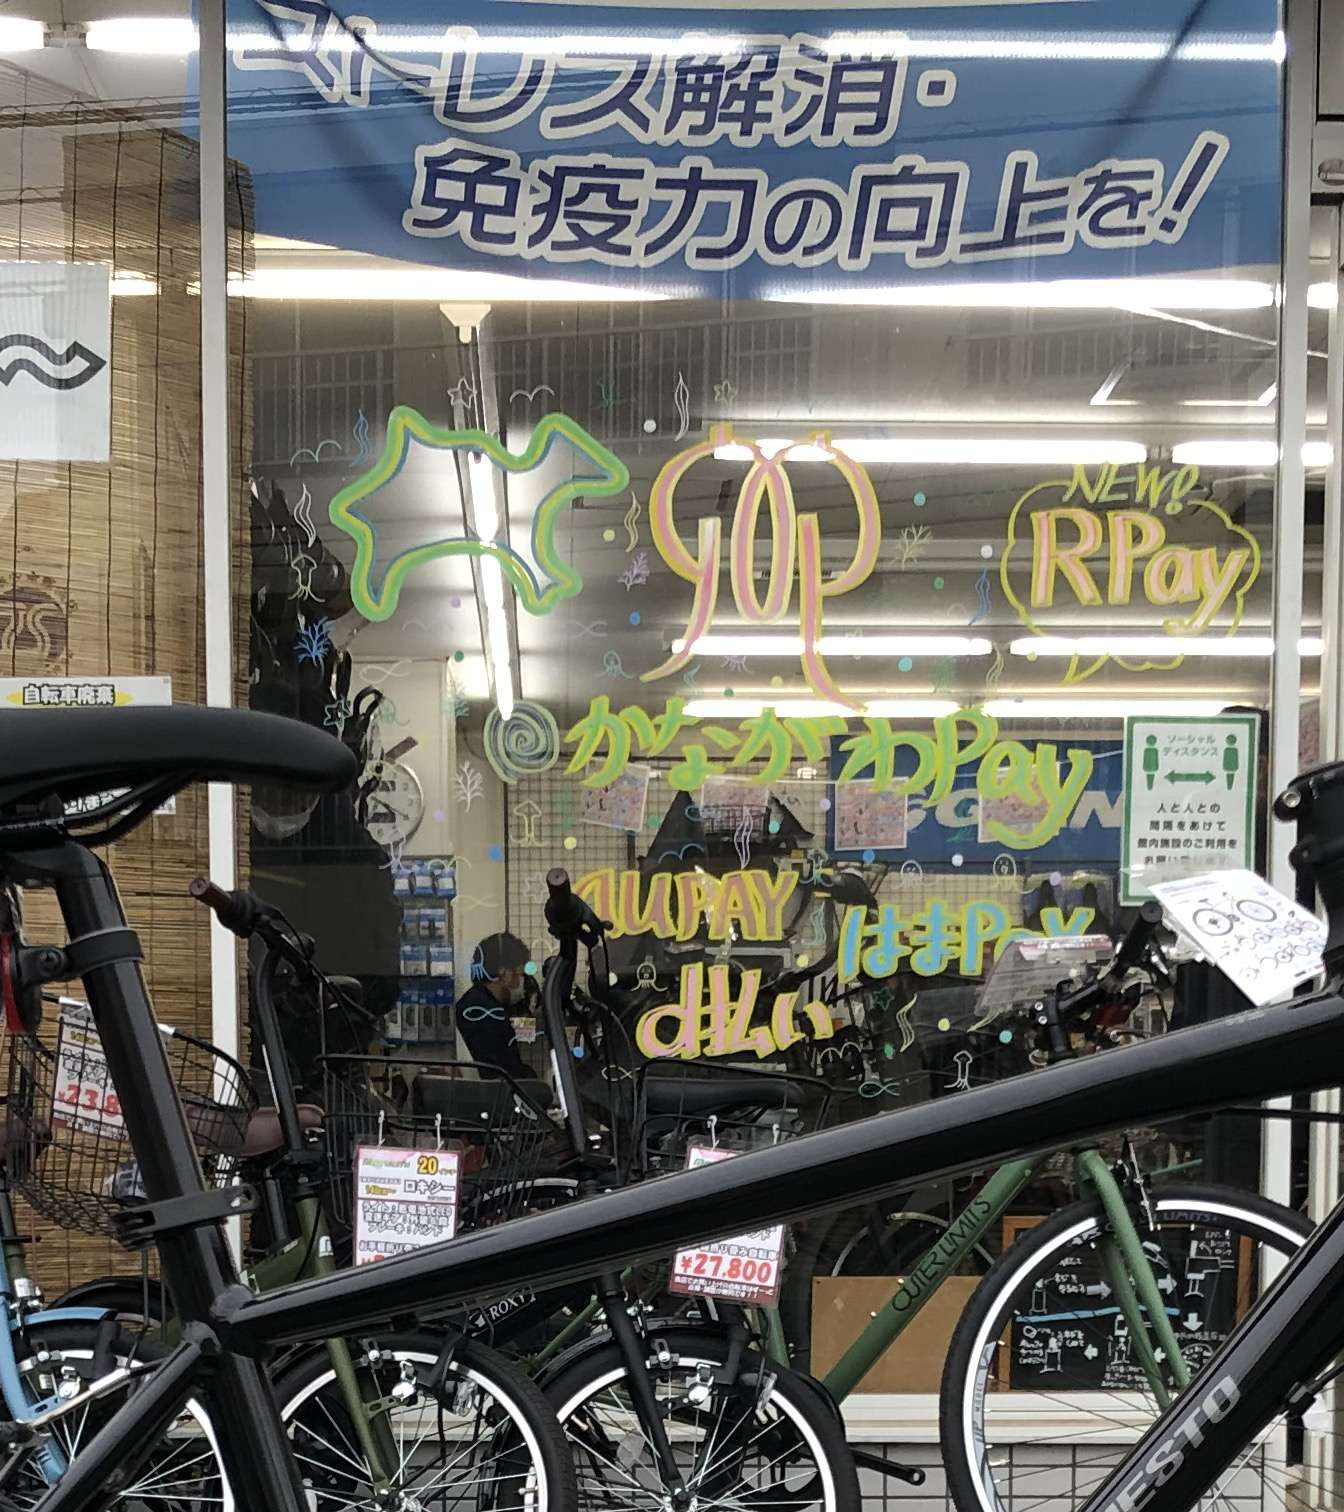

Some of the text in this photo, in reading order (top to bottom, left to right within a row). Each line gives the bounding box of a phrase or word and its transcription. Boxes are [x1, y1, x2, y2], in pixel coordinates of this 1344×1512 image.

[1029, 507, 1251, 636] RPay
[1163, 746, 1218, 757] ディスタンス
[564, 695, 1093, 849] かながわPay
[1156, 803, 1221, 814] 人と人との
[635, 961, 835, 1060] d払い
[417, 1156, 438, 1175] 20
[404, 1179, 456, 1194] ロキシー
[892, 1251, 946, 1312] OUTER
[489, 1294, 526, 1320] ROXY
